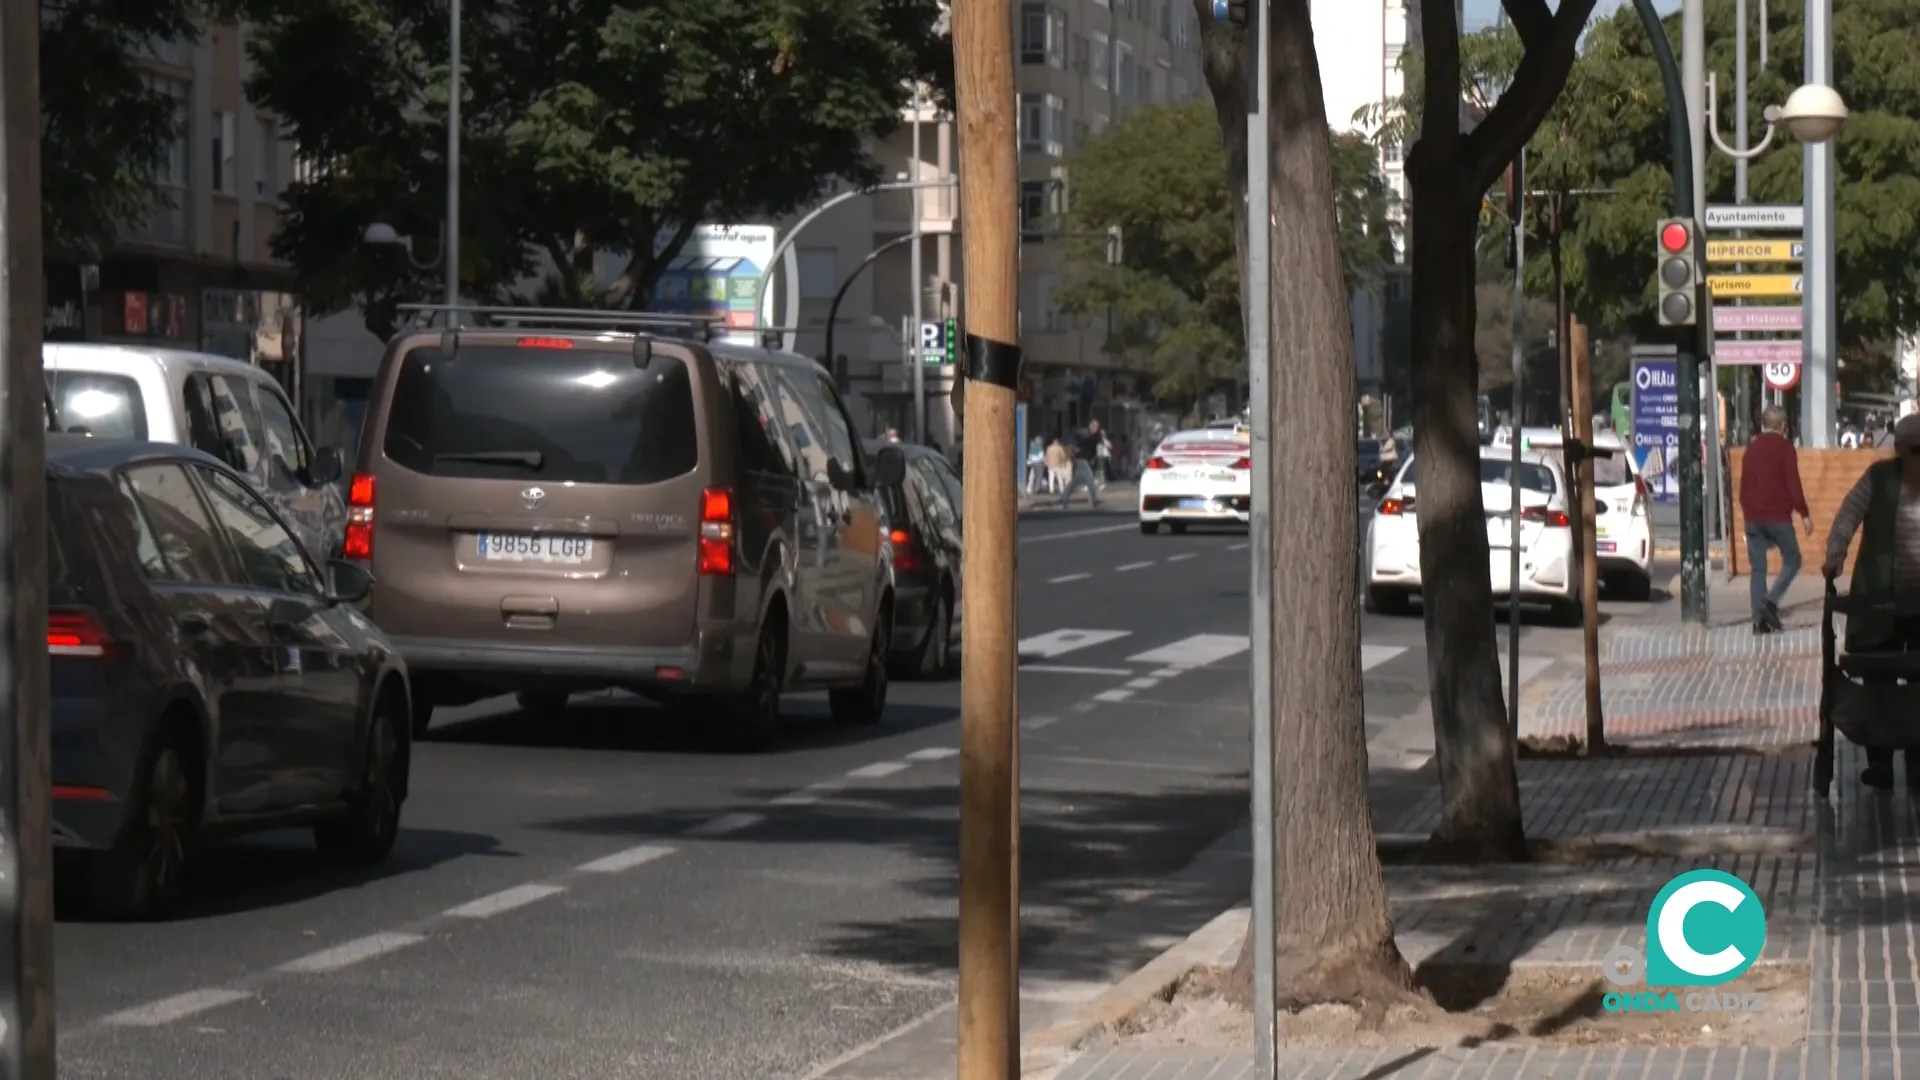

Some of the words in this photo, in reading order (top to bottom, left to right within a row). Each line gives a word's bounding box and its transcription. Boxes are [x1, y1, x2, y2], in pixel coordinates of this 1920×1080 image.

[1707, 211, 1786, 224] Ayuntamiento
[1707, 244, 1772, 256] HIPERCOR
[1708, 279, 1752, 290] Turismo
[1716, 314, 1742, 325] asco
[1770, 362, 1791, 377] 50
[490, 535, 542, 555] 9856
[548, 537, 588, 557] LGB
